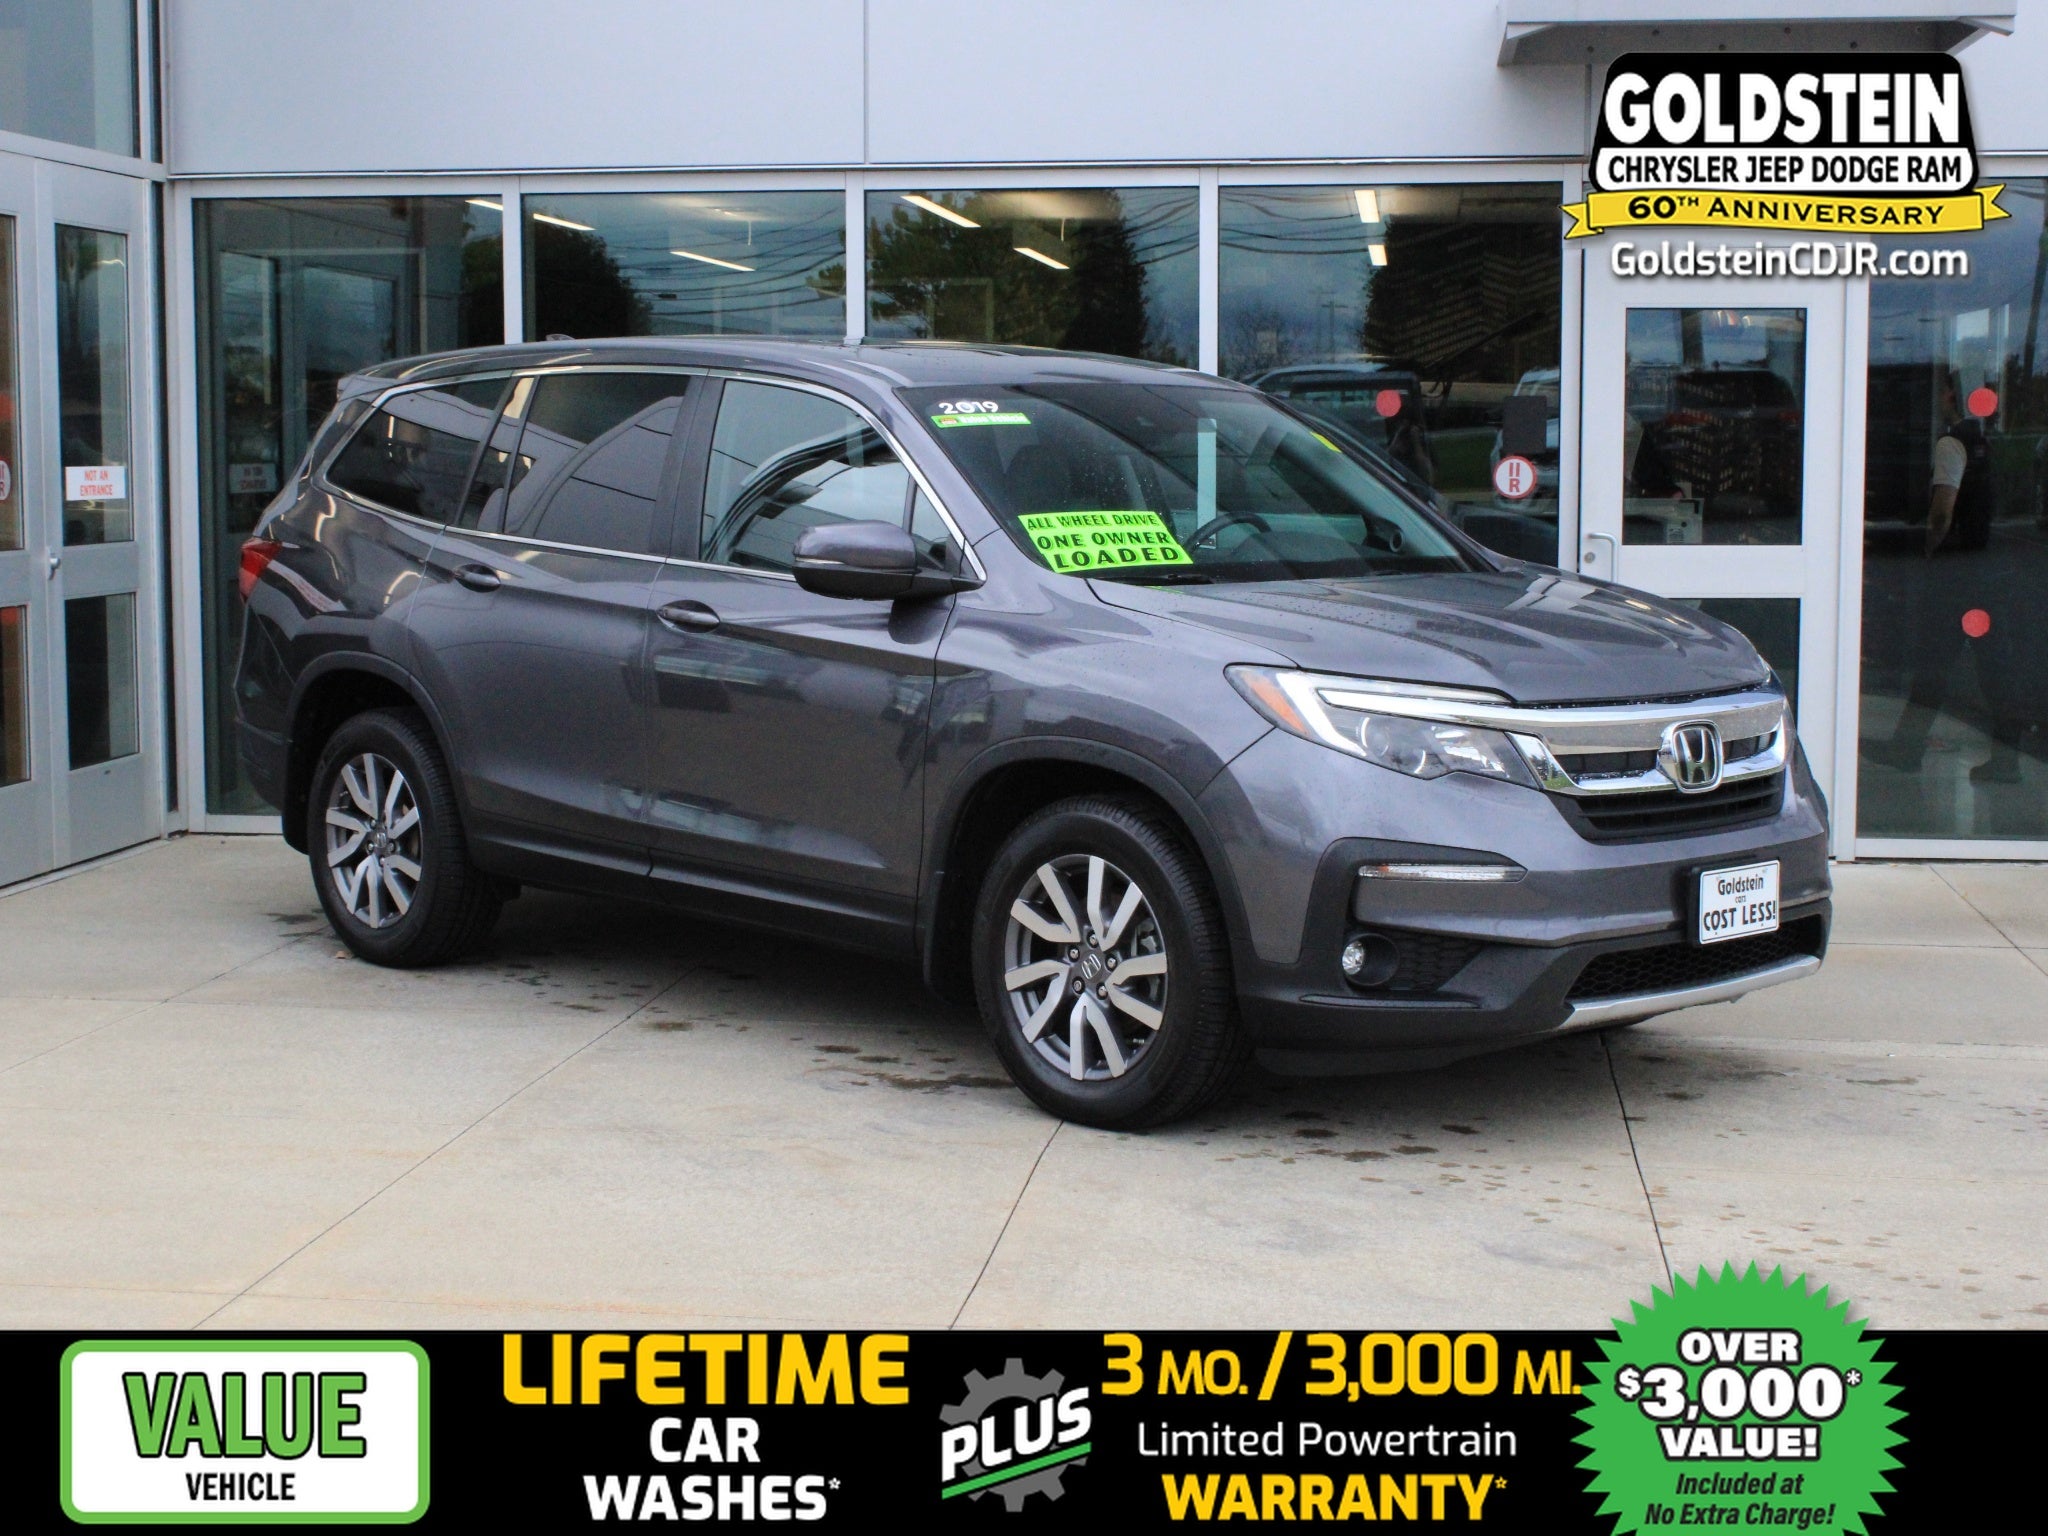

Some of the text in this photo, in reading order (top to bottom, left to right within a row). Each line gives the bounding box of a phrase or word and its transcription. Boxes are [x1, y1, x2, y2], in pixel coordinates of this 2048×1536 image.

[938, 401, 999, 415] 2019
[84, 470, 109, 482] NOT AN
[80, 484, 113, 497] ENTRANCE
[1508, 478, 1520, 493] R
[1027, 514, 1159, 530] ALL WHEEL DRIVE
[1037, 531, 1171, 550] ONE OWNER
[1053, 547, 1180, 569] LOADED
[1717, 874, 1764, 896] Goldstein
[1703, 901, 1776, 932] COST LESS!
